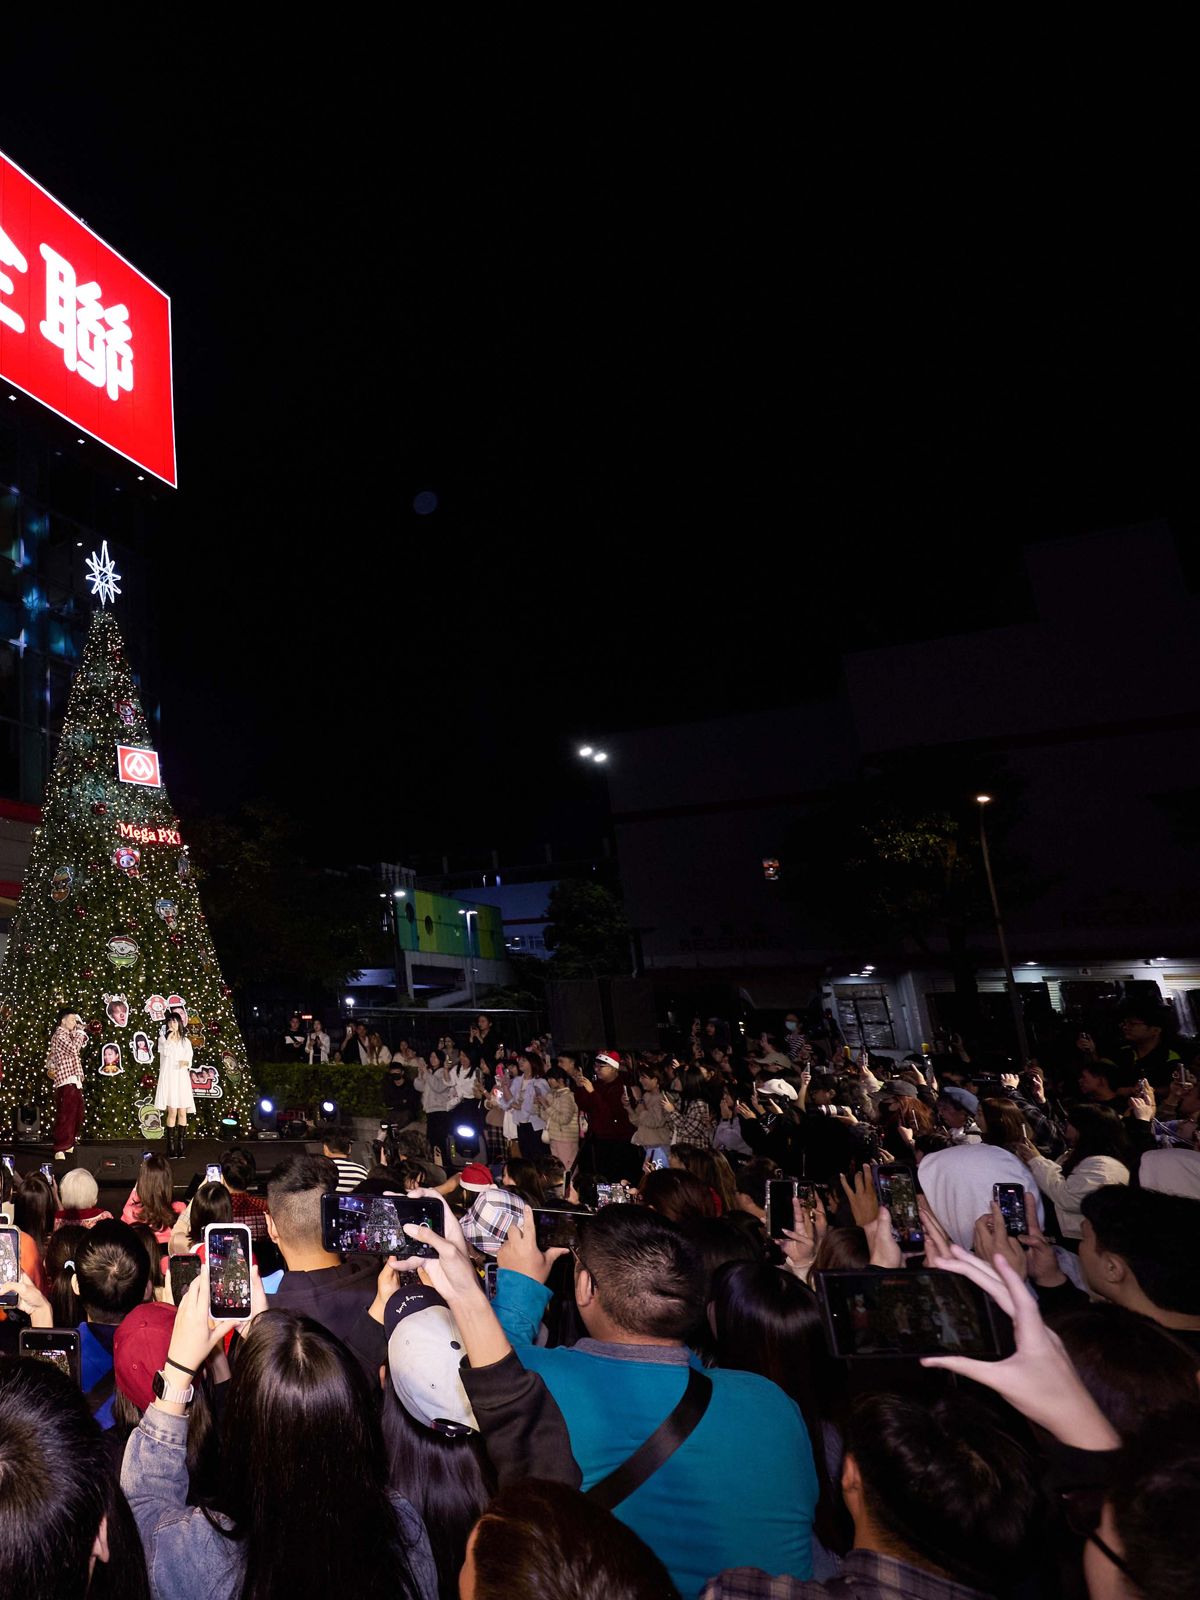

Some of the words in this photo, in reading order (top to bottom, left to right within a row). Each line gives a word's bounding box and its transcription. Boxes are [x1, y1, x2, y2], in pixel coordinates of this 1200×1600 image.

[119, 823, 156, 843] Mega
[157, 828, 178, 845] PX
[679, 935, 784, 951] RECEIVING
